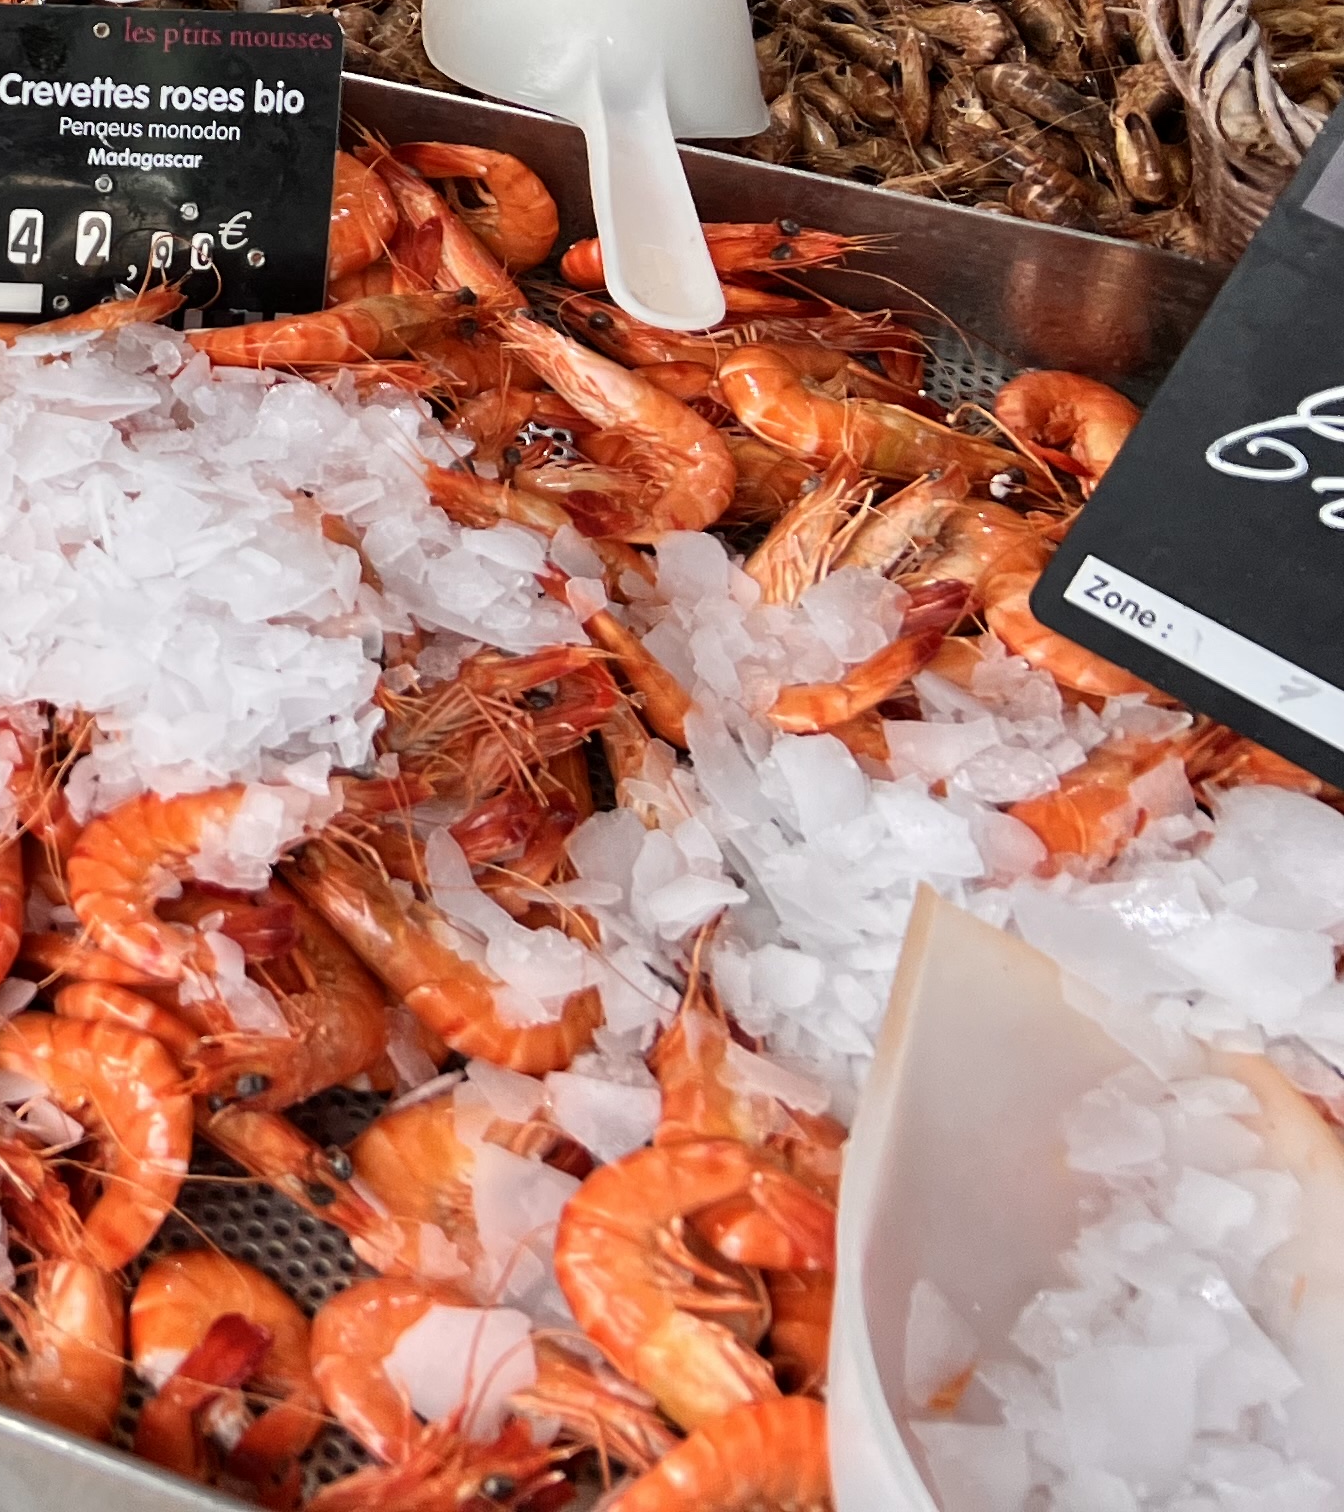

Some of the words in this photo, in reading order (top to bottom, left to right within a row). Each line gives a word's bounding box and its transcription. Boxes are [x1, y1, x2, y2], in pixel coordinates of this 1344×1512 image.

[124, 16, 156, 45] les
[163, 17, 222, 54] p'tits
[230, 24, 333, 51] mousses
[159, 85, 245, 114] roses
[253, 79, 306, 115] bio
[148, 121, 241, 142] monodon
[87, 147, 203, 173] Madagascar
[1083, 574, 1158, 629] Zone
